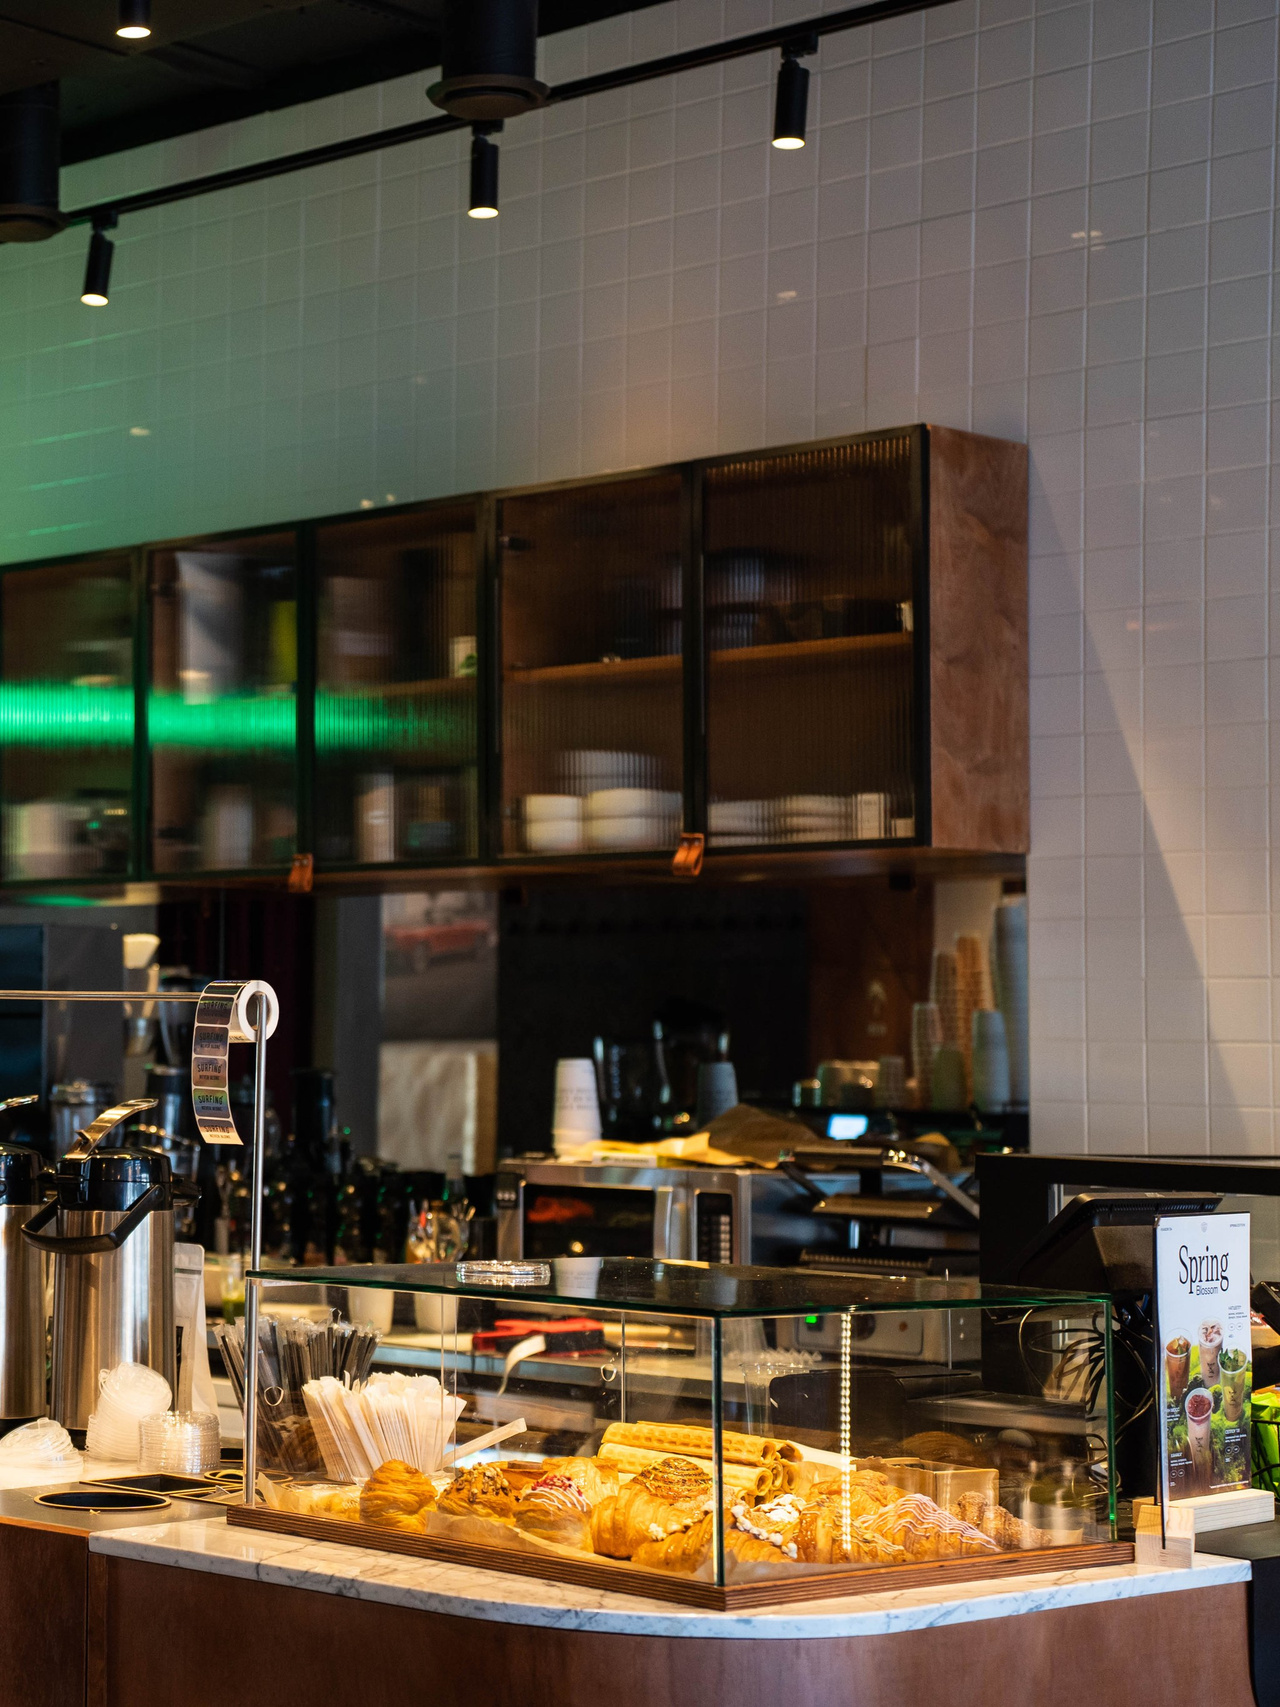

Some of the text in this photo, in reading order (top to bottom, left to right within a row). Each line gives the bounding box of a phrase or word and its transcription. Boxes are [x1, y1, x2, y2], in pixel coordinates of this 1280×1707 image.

[199, 1032, 224, 1043] SURFING
[197, 1063, 222, 1074] SURFING
[198, 1095, 223, 1105] SURFING
[204, 1125, 230, 1134] SURFING
[1179, 1245, 1229, 1294] Spring
[1196, 1285, 1218, 1295] Blossom
